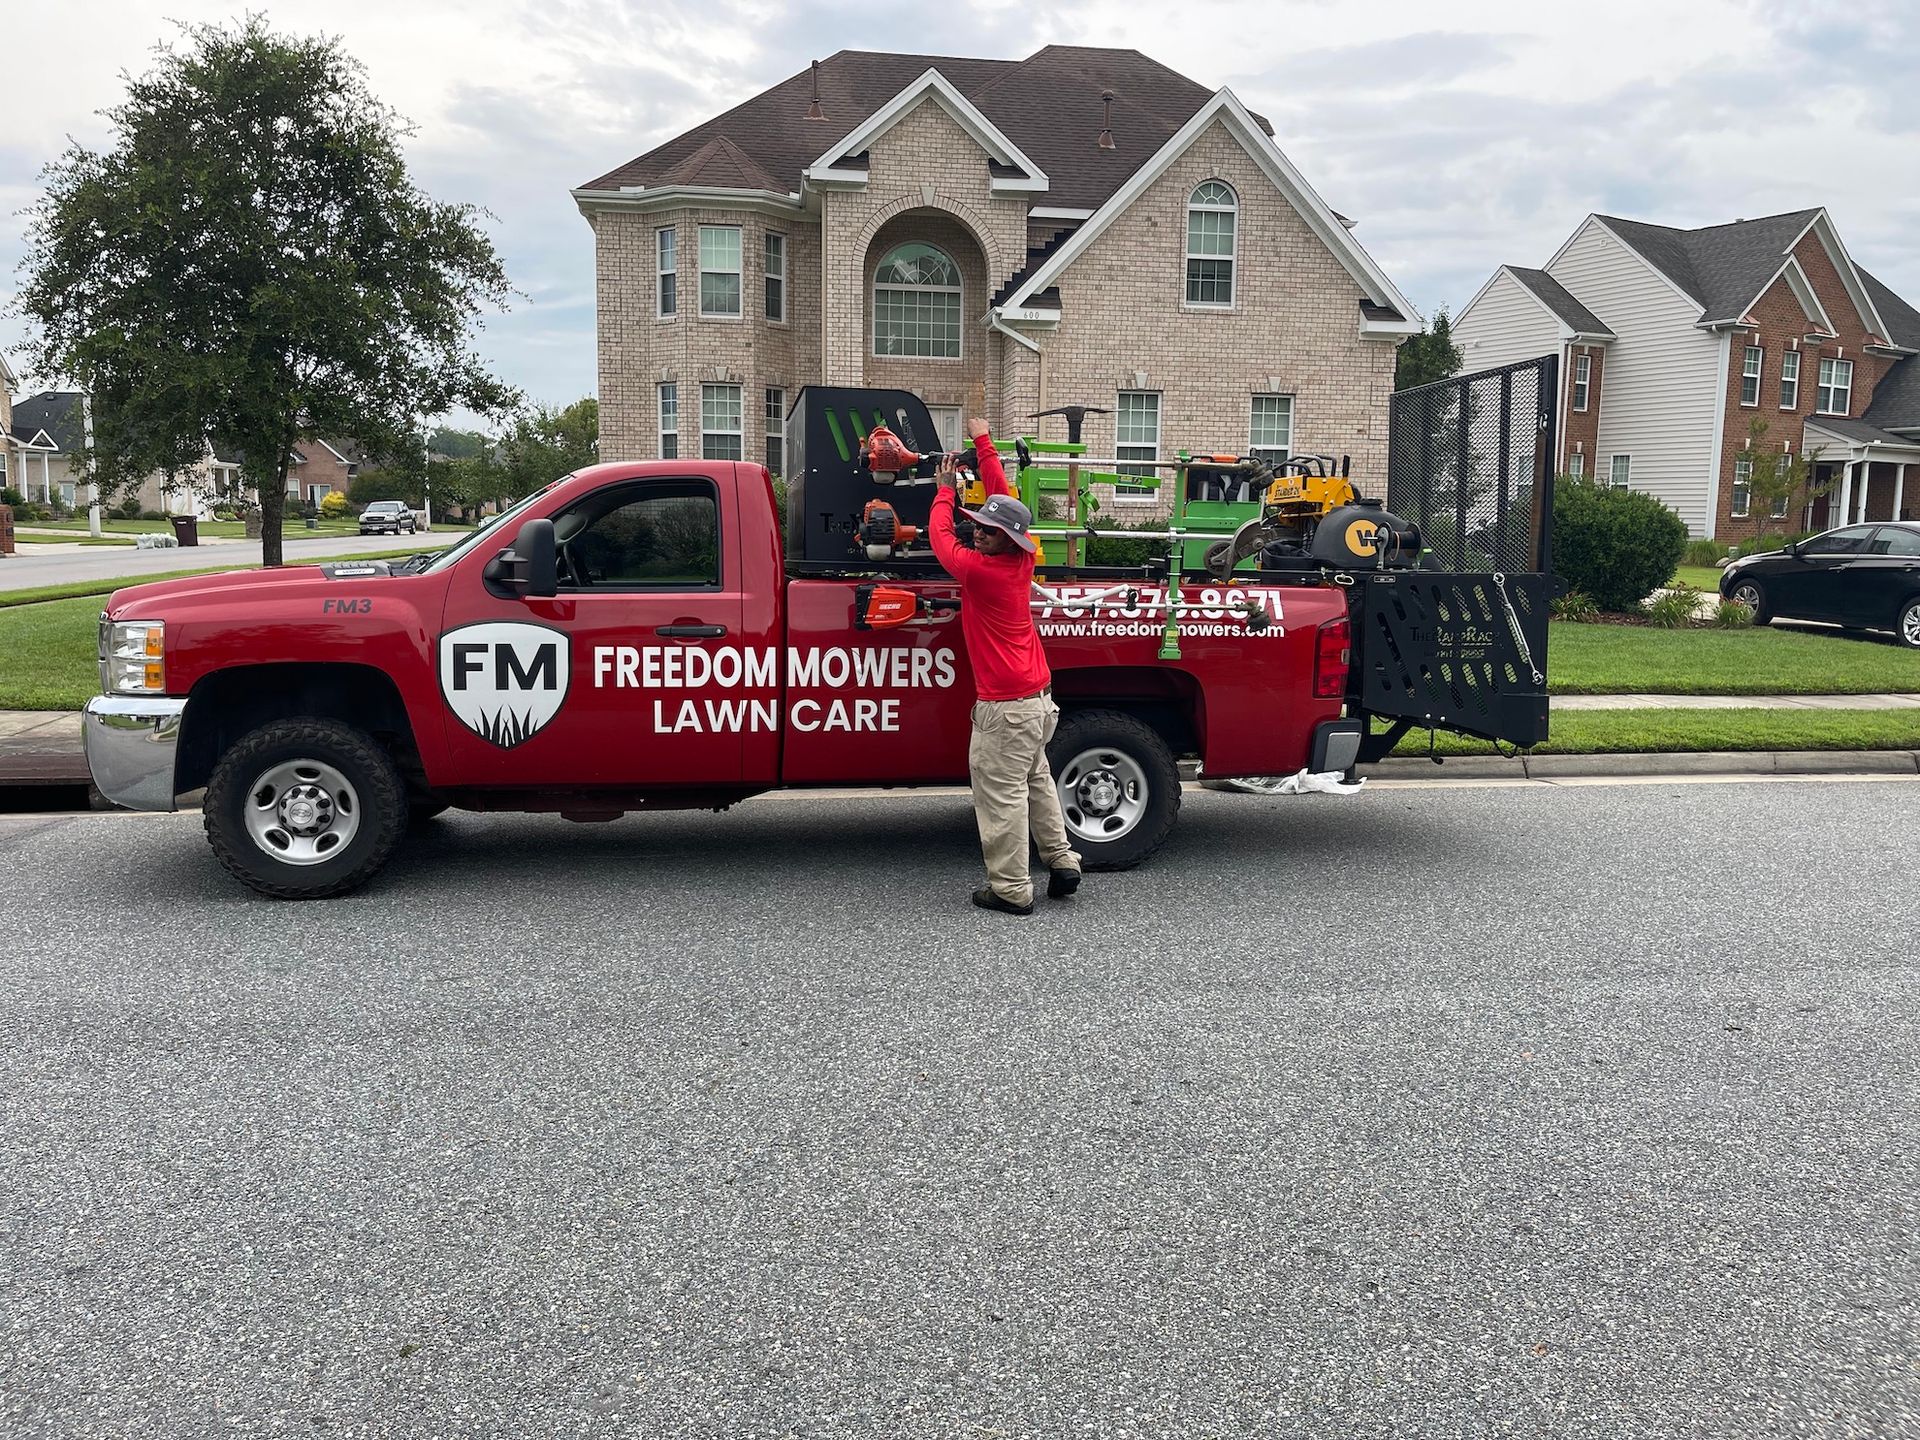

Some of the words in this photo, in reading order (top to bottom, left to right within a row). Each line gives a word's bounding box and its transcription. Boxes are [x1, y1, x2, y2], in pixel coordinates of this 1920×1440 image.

[1024, 311, 1040, 319] 600
[323, 599, 372, 614] FM3
[452, 643, 557, 691] FM
[593, 646, 777, 688] FREEDOM
[787, 647, 955, 688] MOWERS
[653, 699, 778, 733] LAWN
[790, 699, 900, 733] CARE
